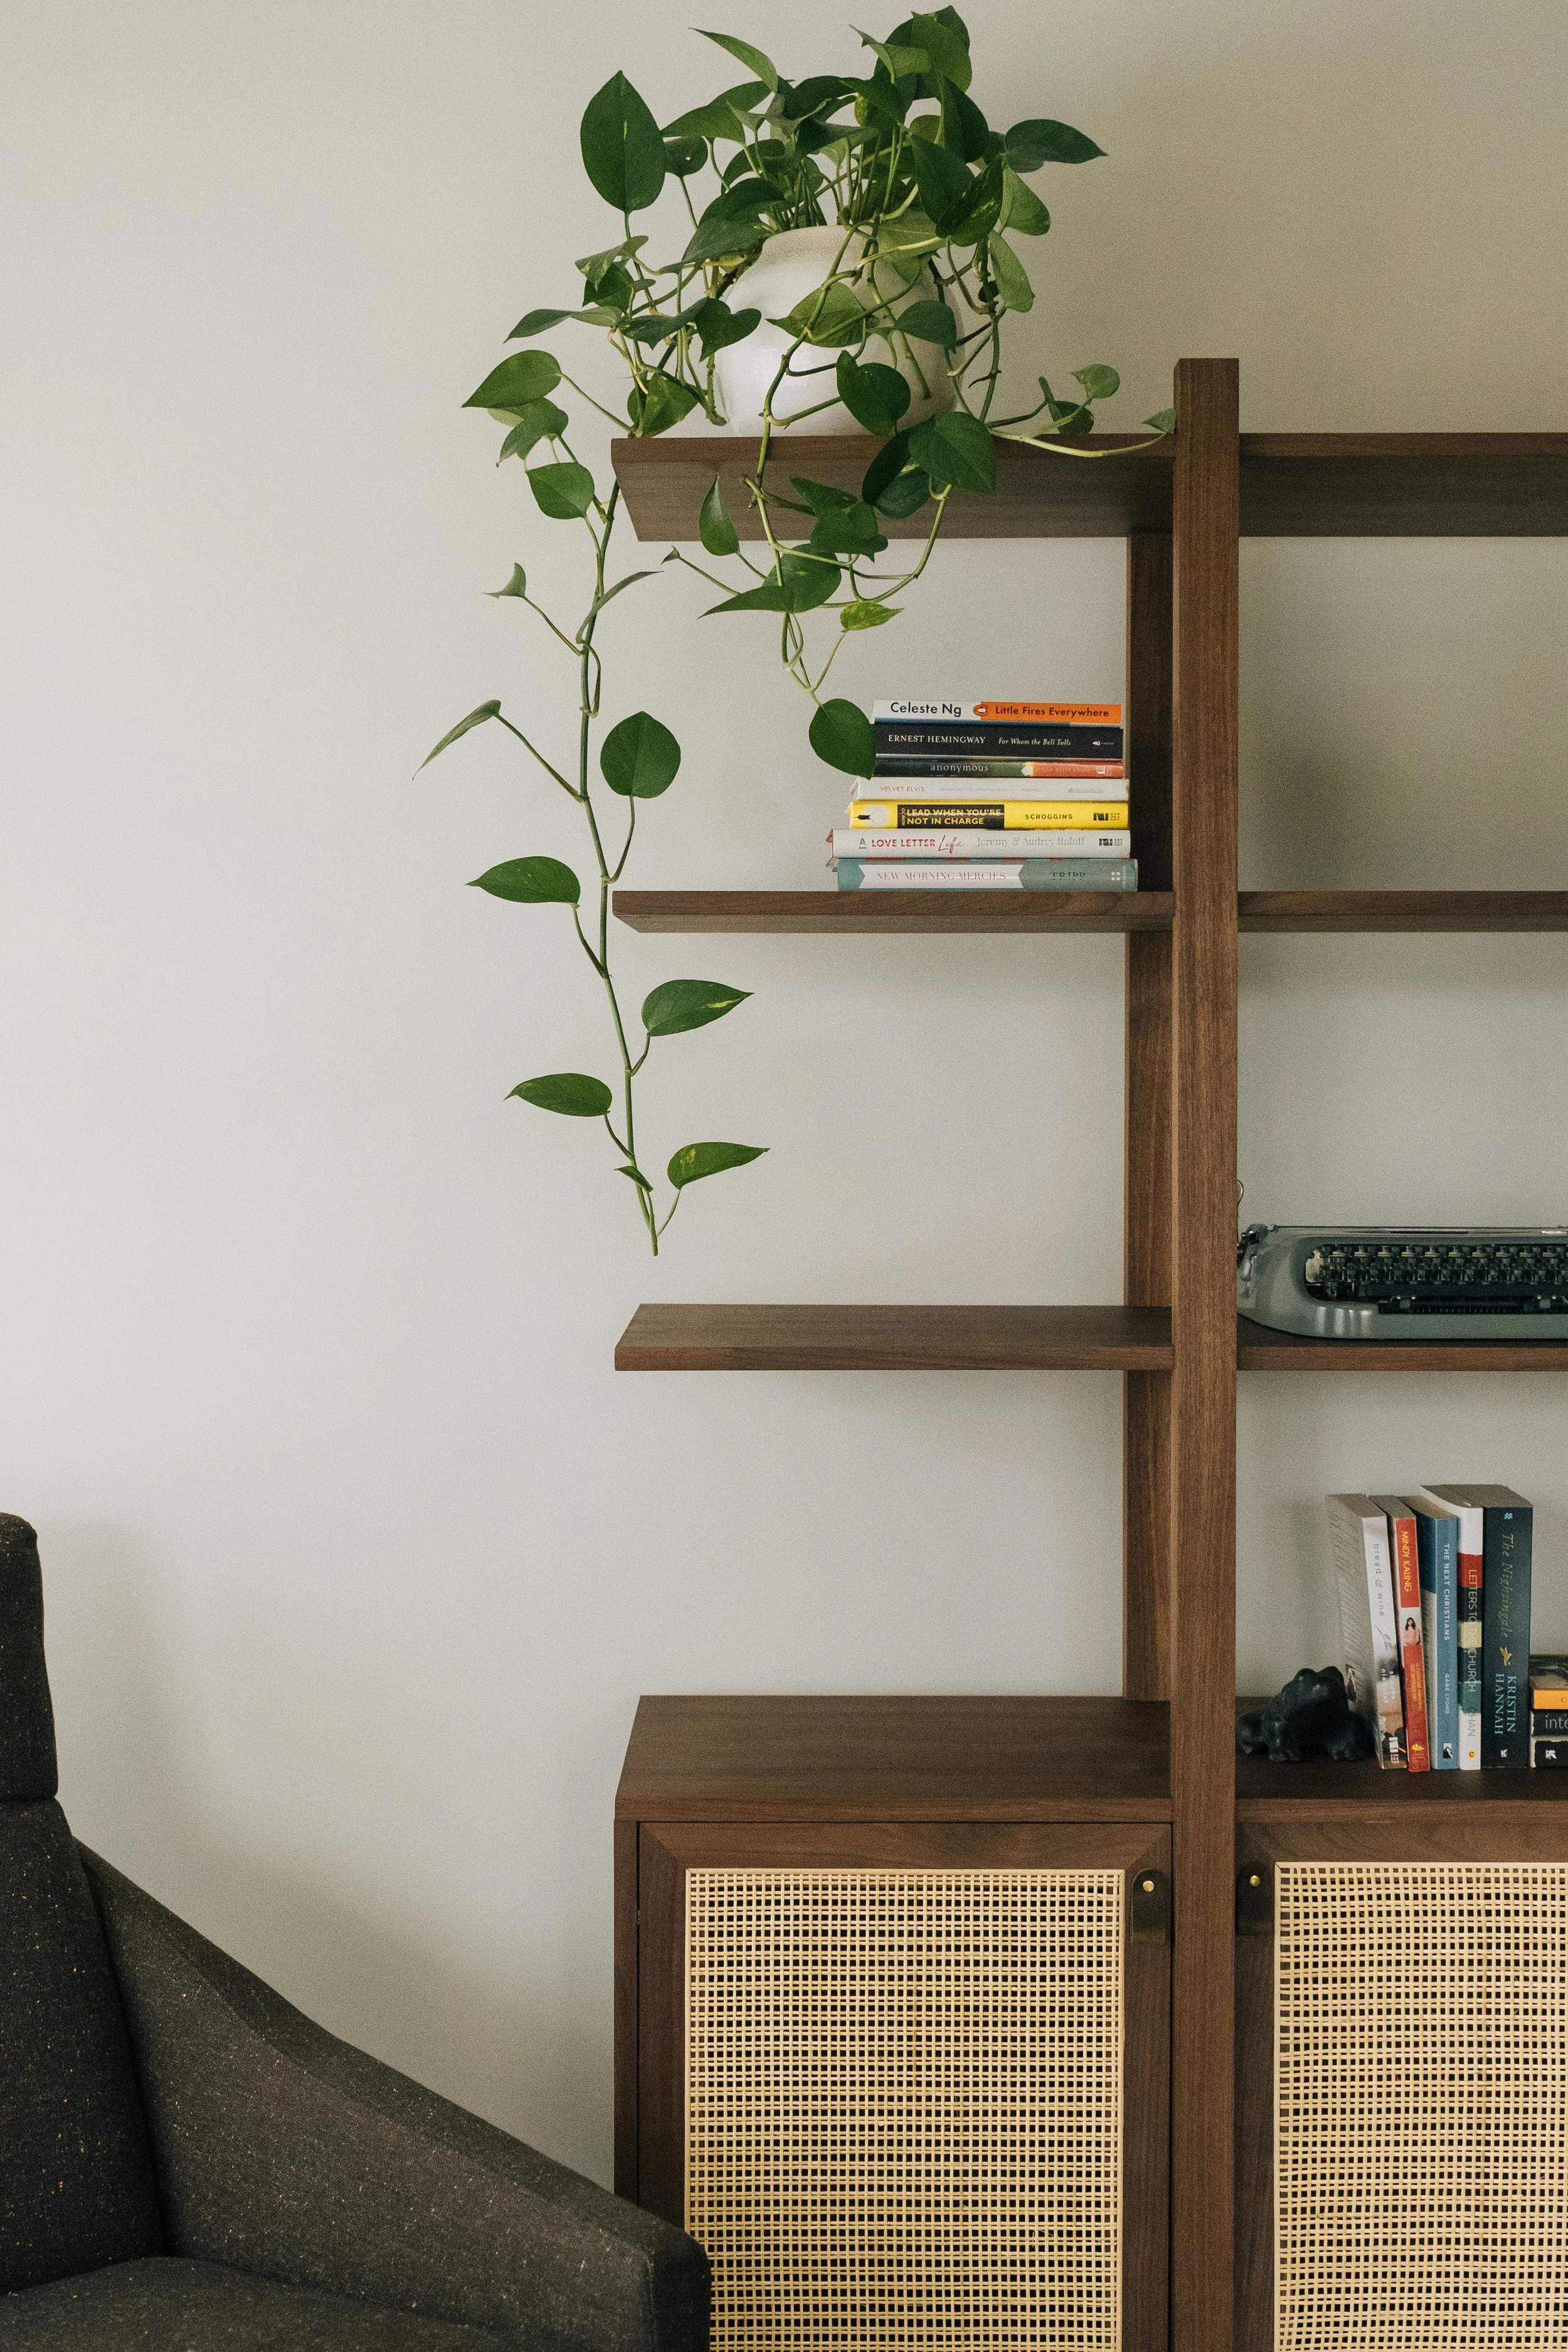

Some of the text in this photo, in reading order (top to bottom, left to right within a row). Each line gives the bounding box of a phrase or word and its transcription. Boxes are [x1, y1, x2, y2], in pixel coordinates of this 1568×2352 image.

[890, 701, 961, 718] Celeste Ng
[995, 706, 1109, 718] Little Fires Everywhere
[928, 735, 986, 744] HEMINGWAY
[930, 765, 988, 773] anonymous
[907, 808, 931, 817] LEAD
[933, 808, 964, 817] WHEN
[872, 839, 897, 847] LOVE
[901, 839, 936, 847] LETTER
[938, 835, 965, 854] Life
[975, 837, 1009, 847] Jeremy
[1024, 837, 1055, 847] Audrey
[1057, 837, 1085, 846] Roloff
[877, 872, 1006, 881] NEW MORNING MERCIES
[1051, 871, 1086, 881] TRIPP
[1373, 1544, 1383, 1574] bread
[1375, 1579, 1384, 1587] &
[1402, 1560, 1412, 1592] KALING
[1468, 1569, 1477, 1610] LETTERS
[1497, 1534, 1513, 1638] The Nightingale
[1468, 1613, 1477, 1624] TO
[1468, 1648, 1477, 1692] CHURCH
[1495, 1673, 1505, 1734] HANNAH
[1507, 1675, 1517, 1732] KRISTIN
[1468, 1706, 1476, 1737] CHAN
